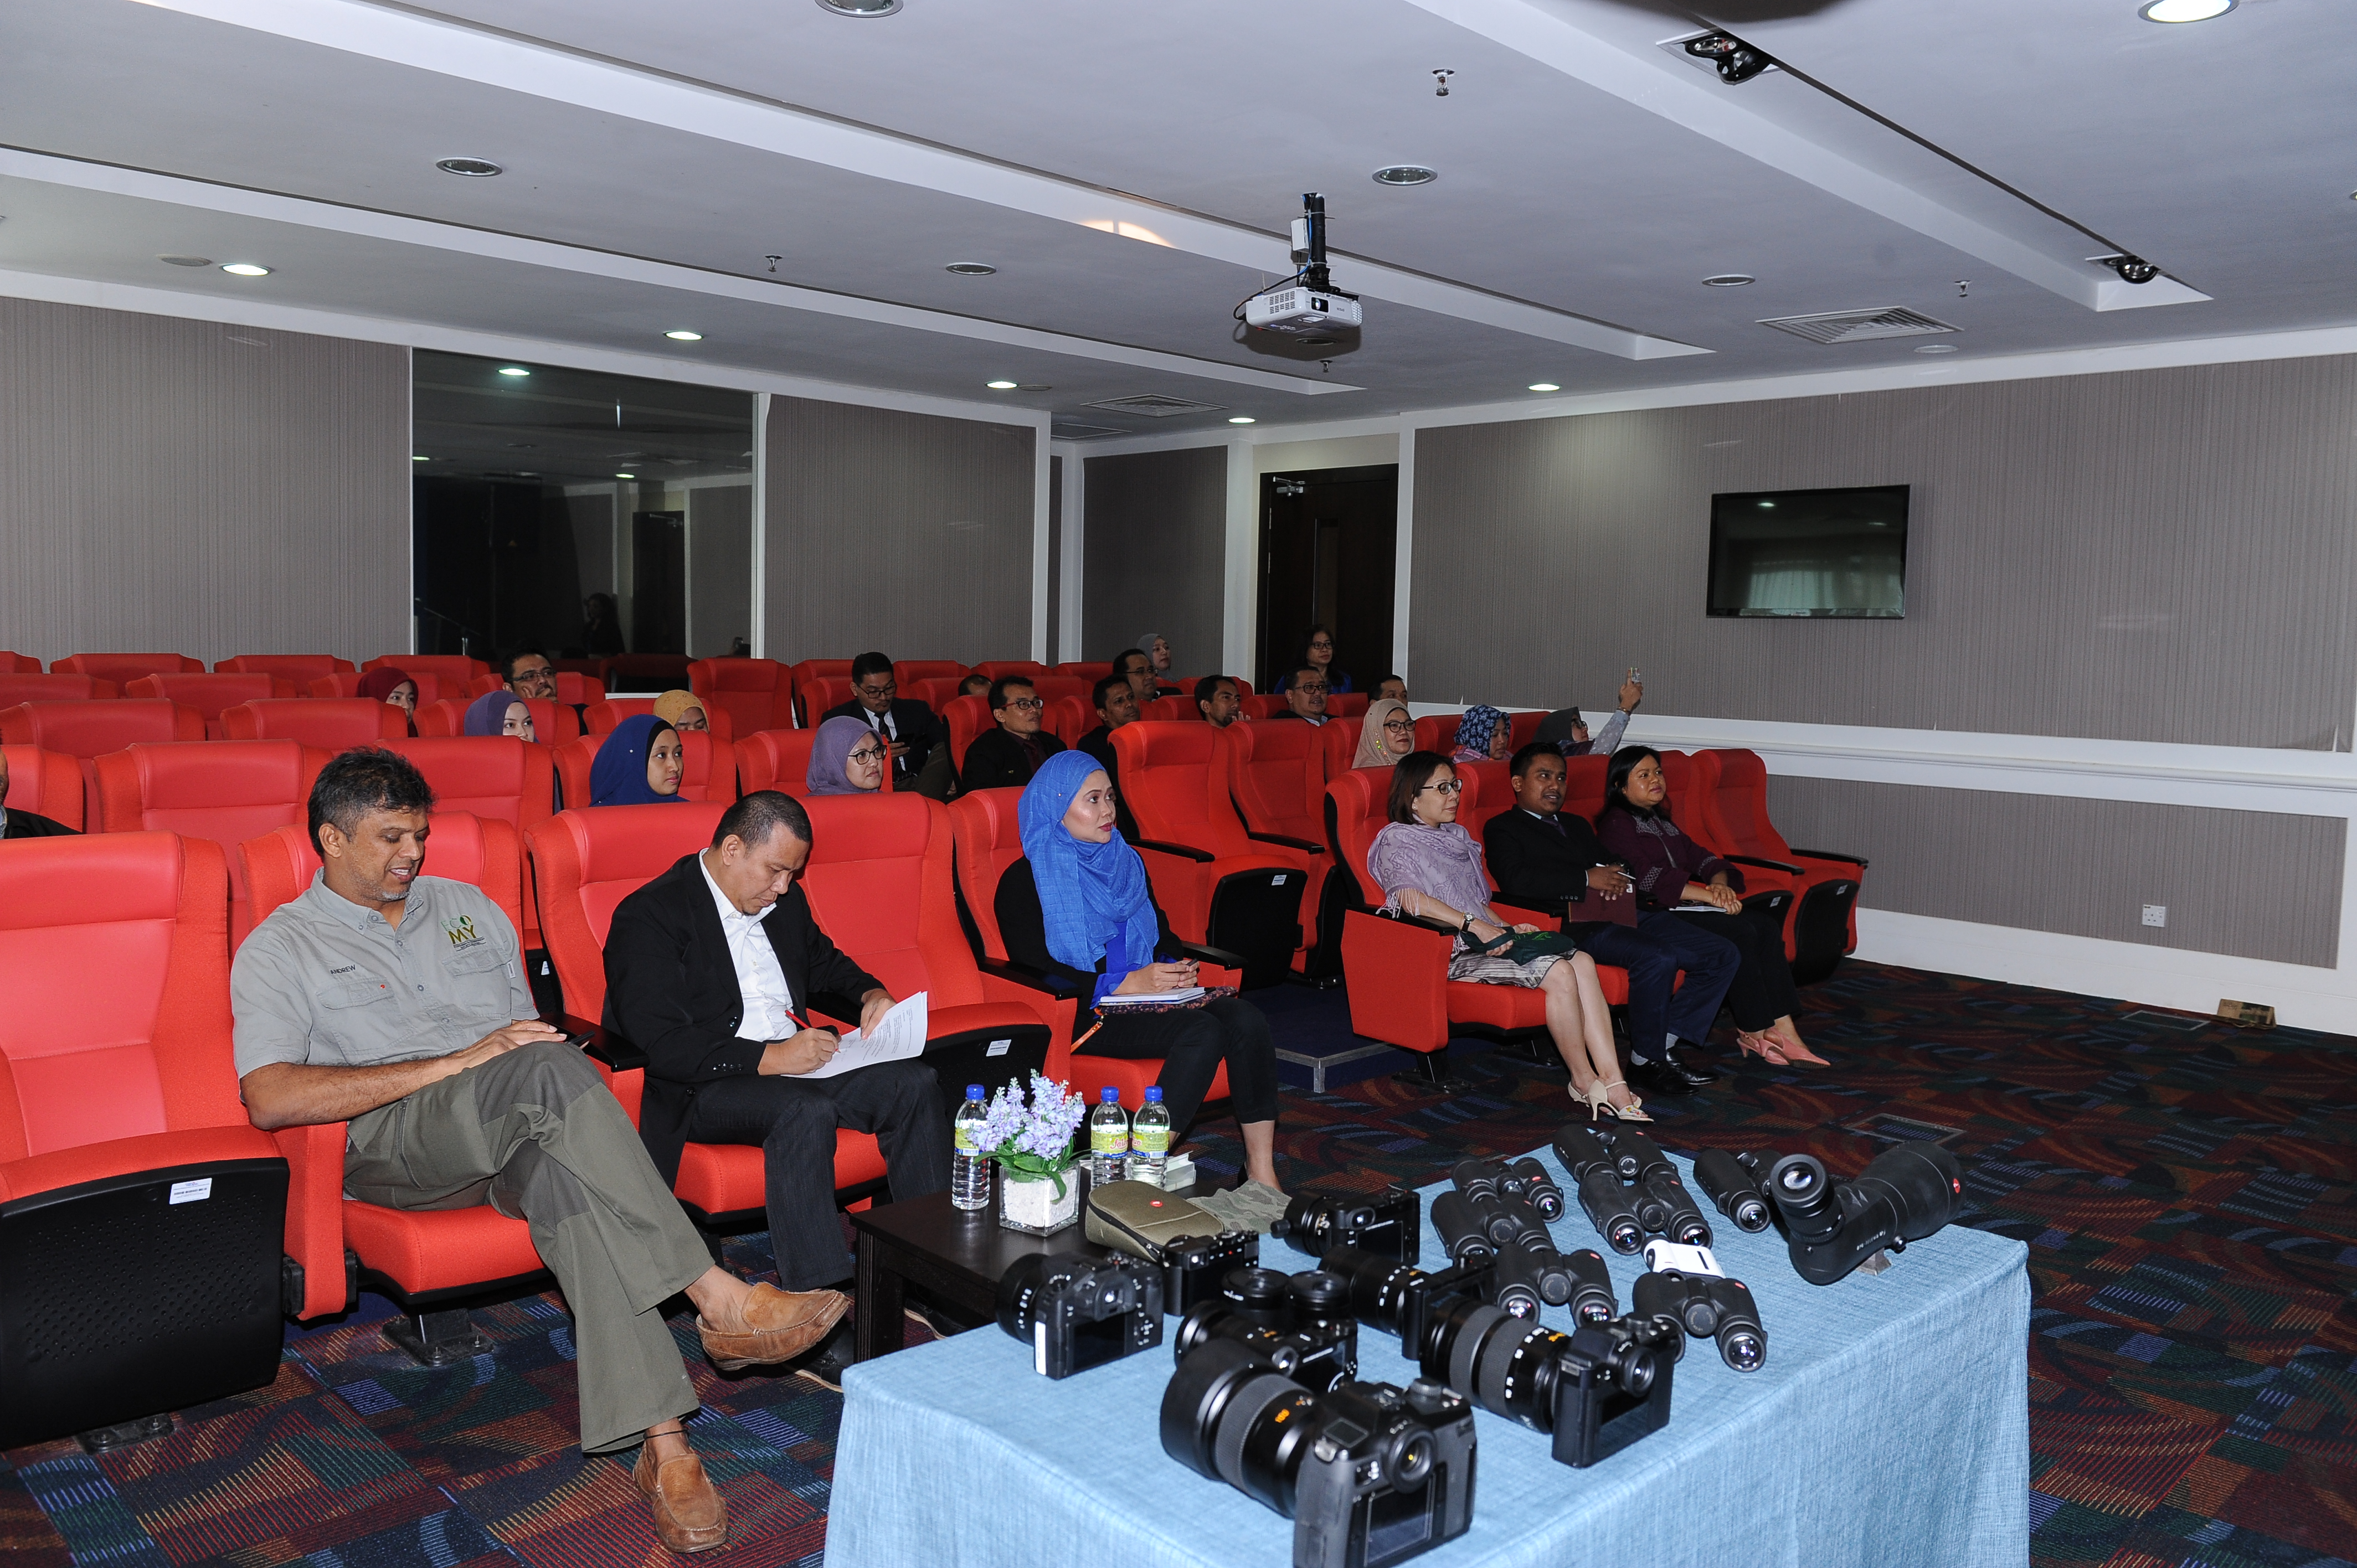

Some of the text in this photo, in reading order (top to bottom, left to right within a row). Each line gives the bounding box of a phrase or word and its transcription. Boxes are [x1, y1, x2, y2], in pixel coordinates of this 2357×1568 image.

[441, 915, 472, 931] ECO
[448, 925, 477, 945] MY
[330, 964, 356, 974] ANDREW
